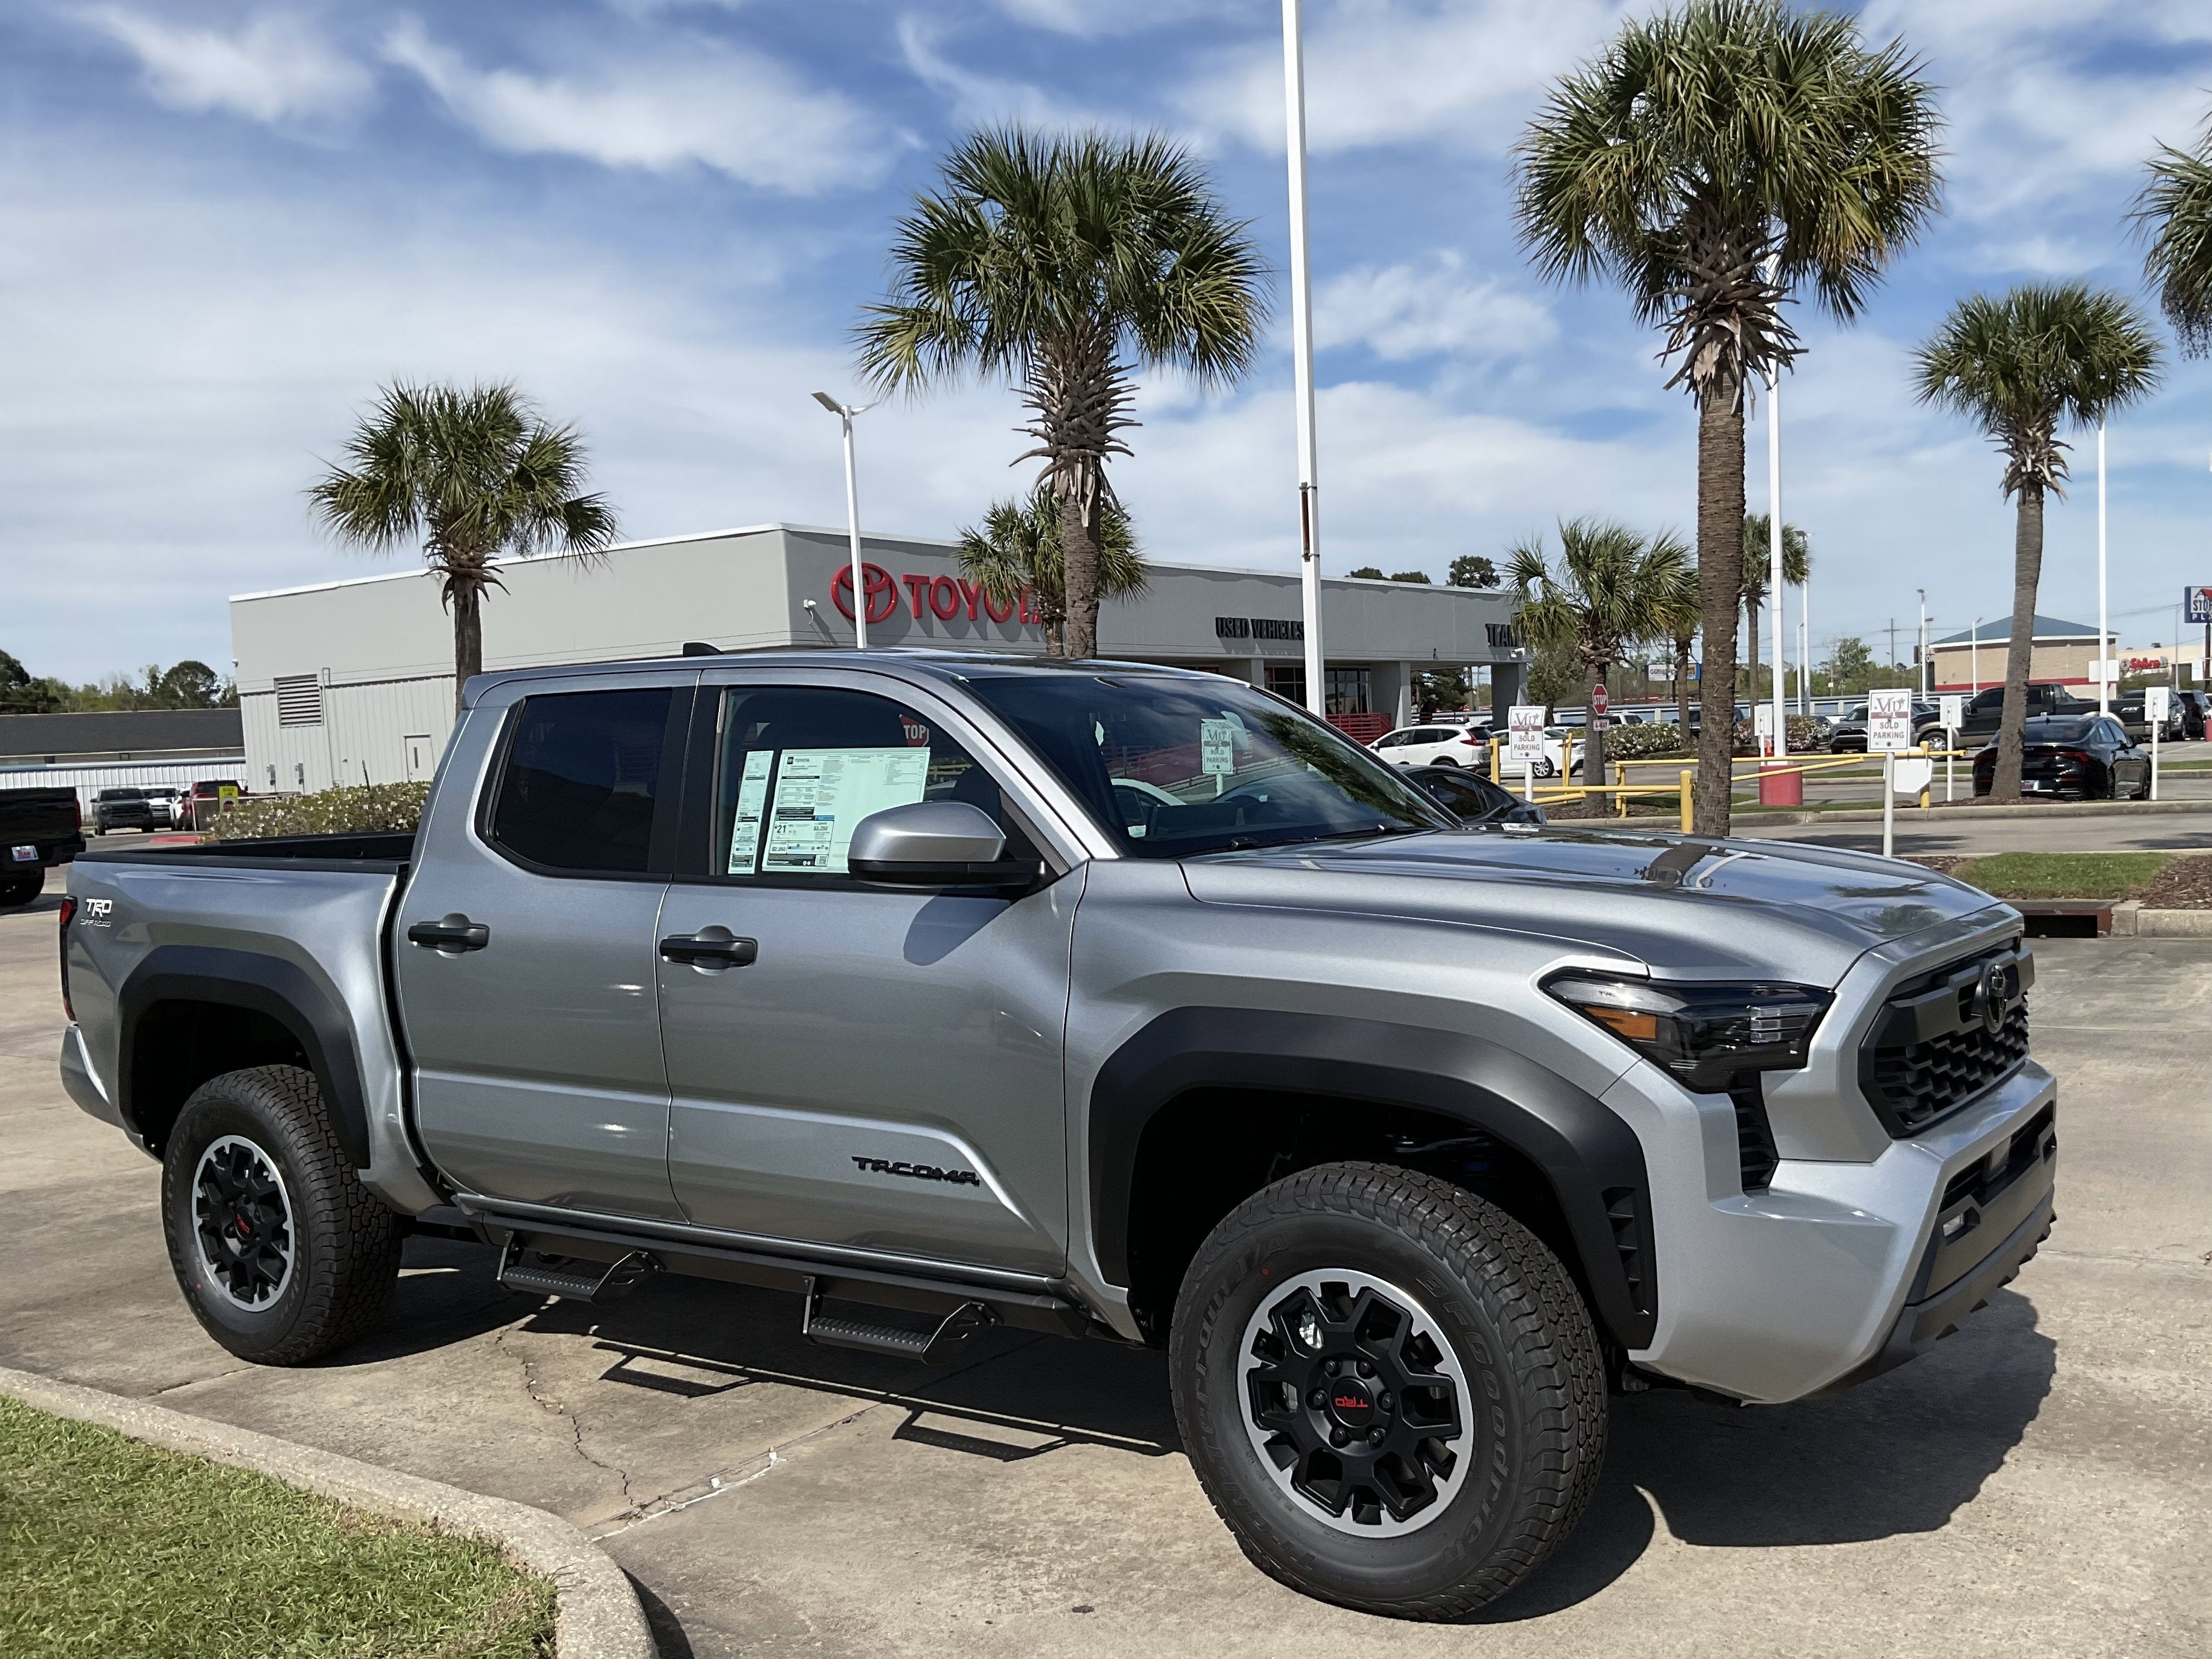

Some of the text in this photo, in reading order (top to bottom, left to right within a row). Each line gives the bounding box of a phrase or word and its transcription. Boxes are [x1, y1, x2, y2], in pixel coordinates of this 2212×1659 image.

[903, 574, 1042, 624] TOYOT
[1215, 617, 1304, 640] USED VEHICLES
[1594, 694, 1606, 705] STOP
[903, 724, 927, 739] TOP
[777, 825, 786, 834] 21
[86, 898, 112, 918] TRD
[851, 1156, 980, 1186] TACOMA
[1335, 1396, 1369, 1408] TRD
